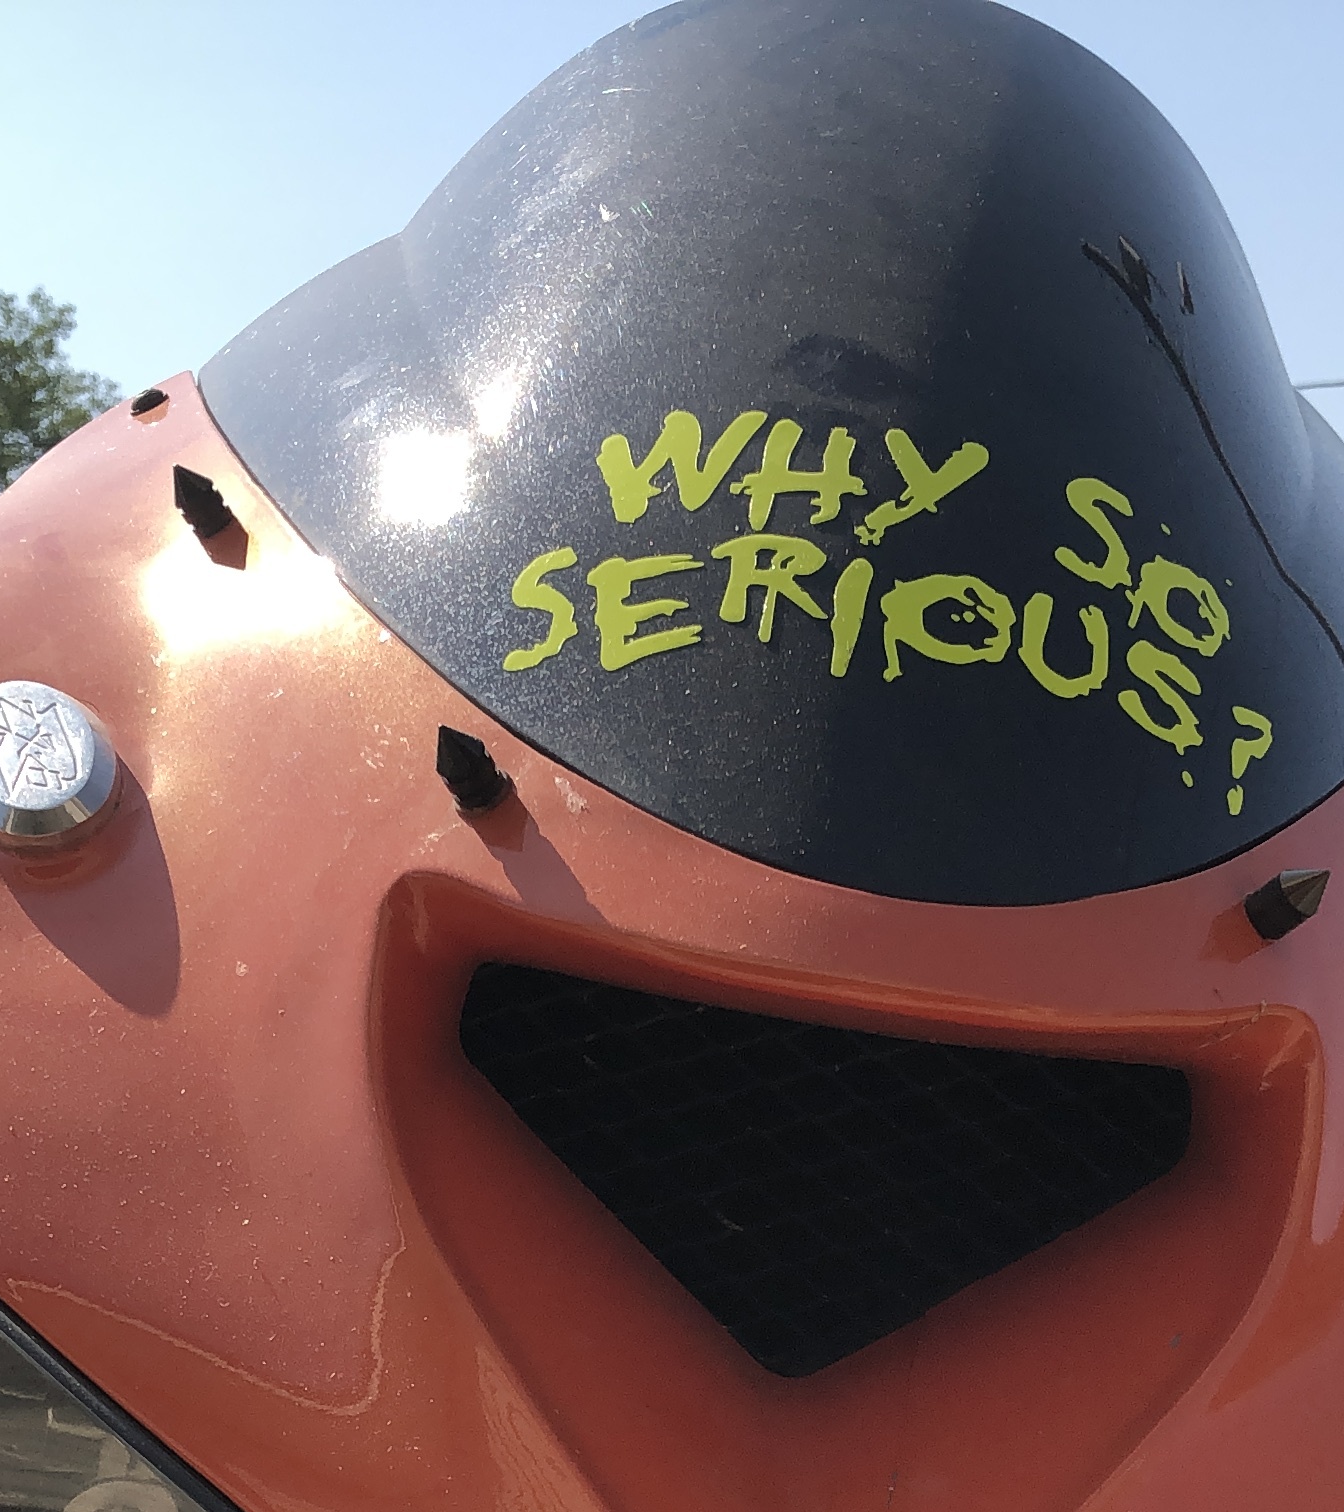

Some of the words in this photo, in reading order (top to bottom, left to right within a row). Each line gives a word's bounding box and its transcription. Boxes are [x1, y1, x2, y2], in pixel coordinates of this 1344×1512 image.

[596, 411, 990, 546] WHY
[1055, 478, 1230, 657] SO
[502, 534, 1273, 816] SERIOUS?
